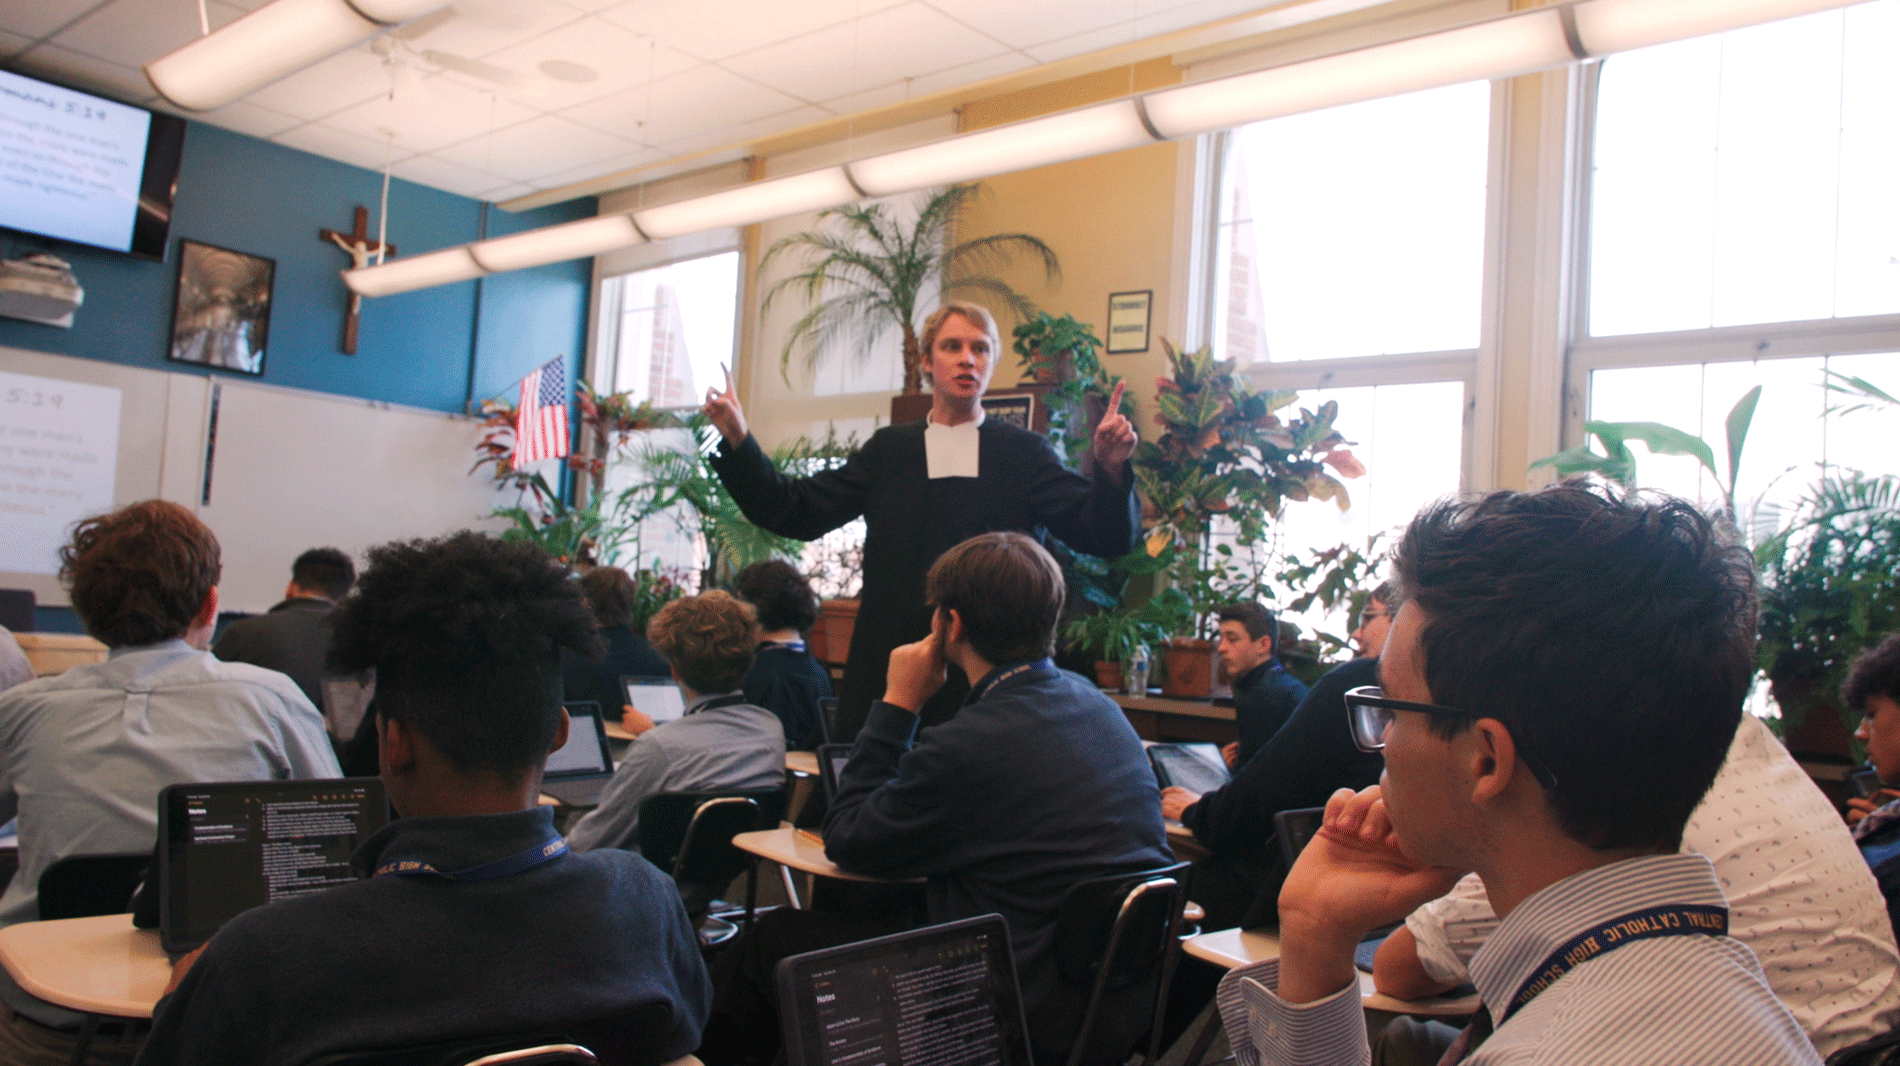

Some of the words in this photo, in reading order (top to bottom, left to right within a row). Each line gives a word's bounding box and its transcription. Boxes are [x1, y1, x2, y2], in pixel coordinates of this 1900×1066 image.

[6, 387, 64, 409] 5:19
[1603, 912, 1681, 943] CATHOLIC
[1563, 936, 1601, 967] HIGH
[816, 993, 836, 1004] Notes
